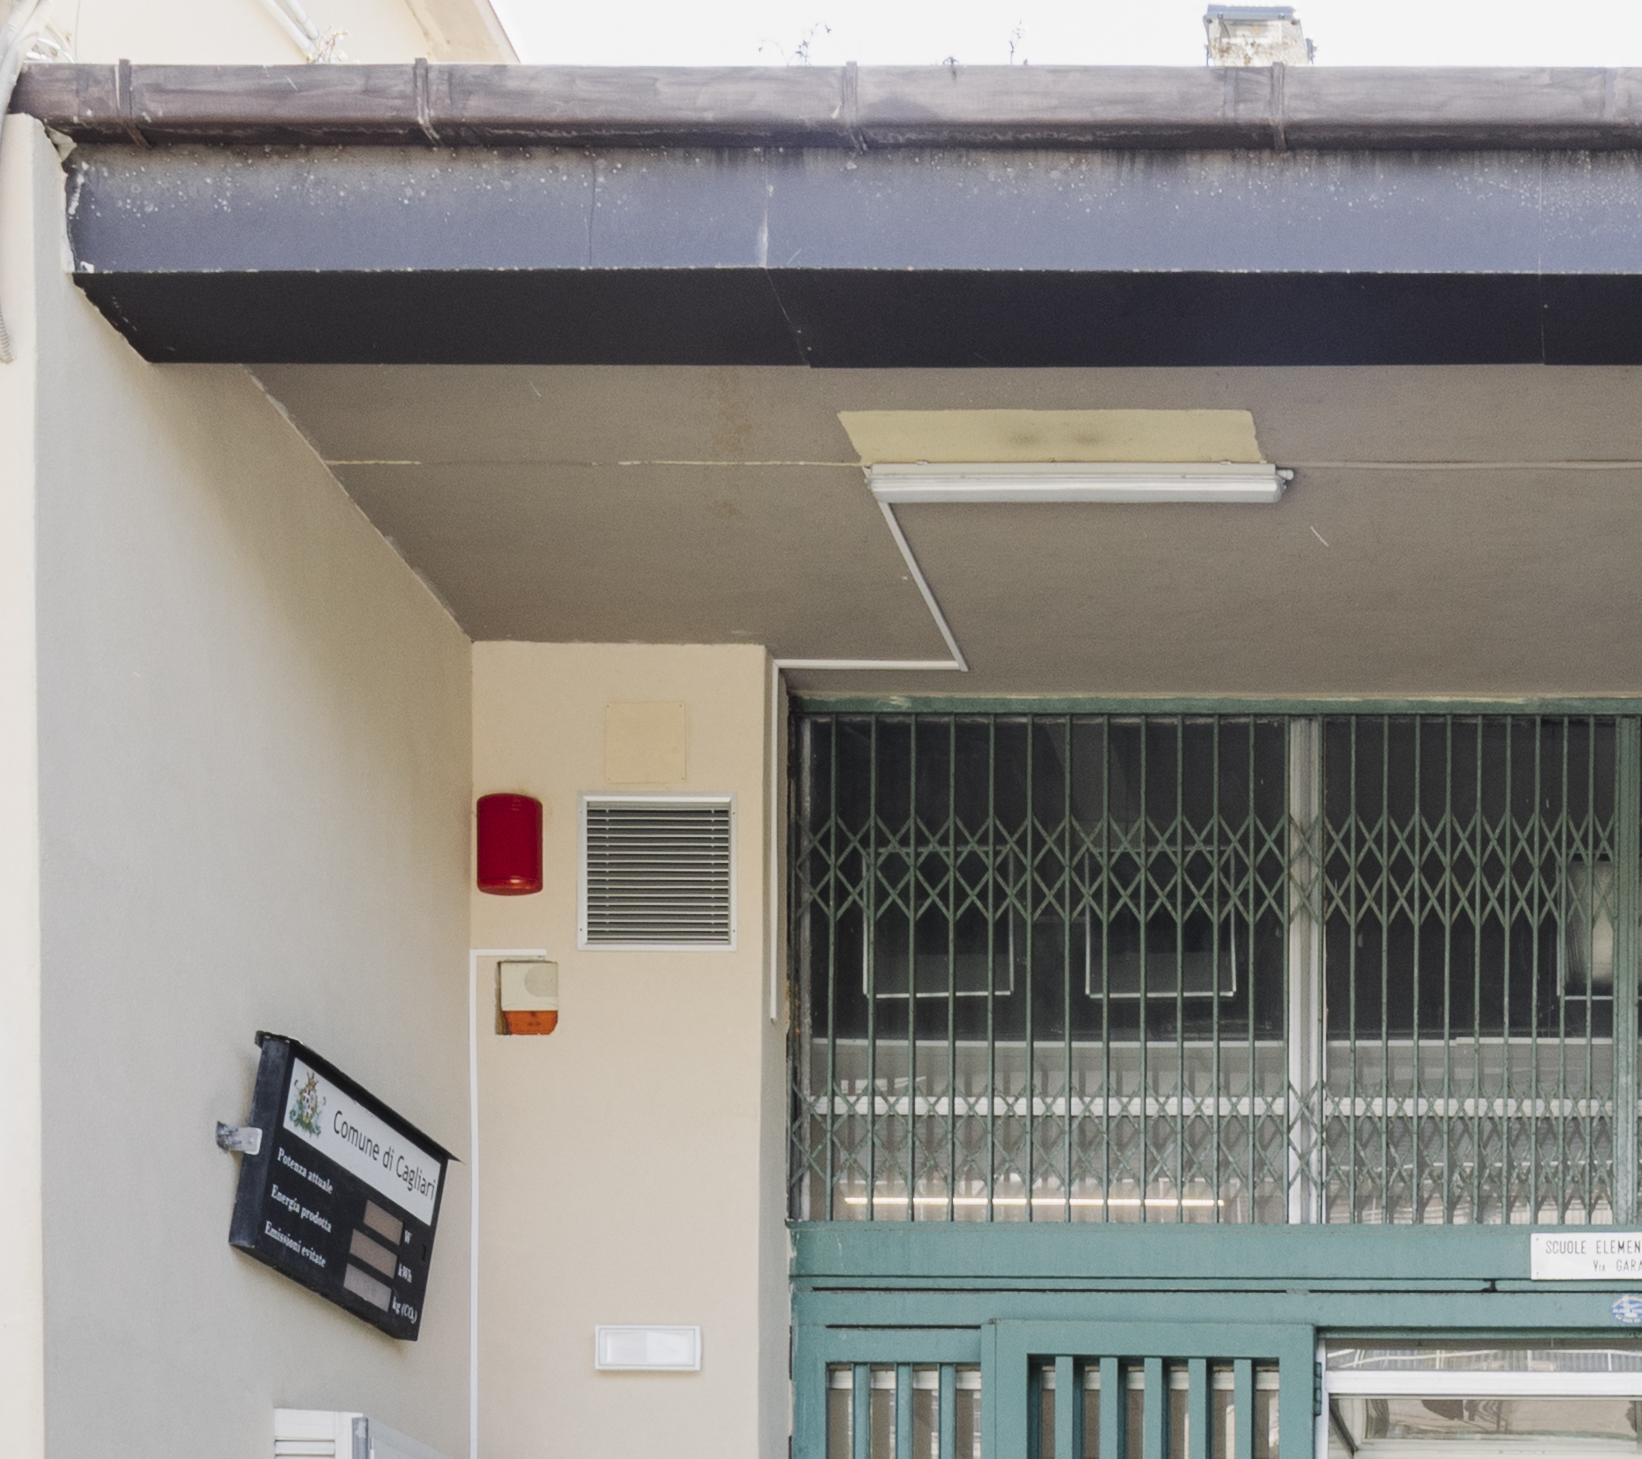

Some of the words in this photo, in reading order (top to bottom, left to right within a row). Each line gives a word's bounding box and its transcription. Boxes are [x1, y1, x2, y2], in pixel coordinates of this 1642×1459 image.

[277, 1147, 307, 1177] Potenza
[307, 1169, 334, 1195] attuale
[333, 1110, 380, 1161] Comune
[382, 1145, 395, 1172] di
[396, 1155, 437, 1201] Cagliari
[270, 1184, 301, 1214] Energia
[300, 1205, 333, 1234] prodotta
[264, 1220, 301, 1255] Emissioni
[301, 1244, 327, 1268] evitate
[404, 1229, 413, 1245] W
[1545, 1239, 1587, 1255] SCUOLE
[397, 1262, 414, 1284] kWh
[391, 1296, 402, 1315] kg
